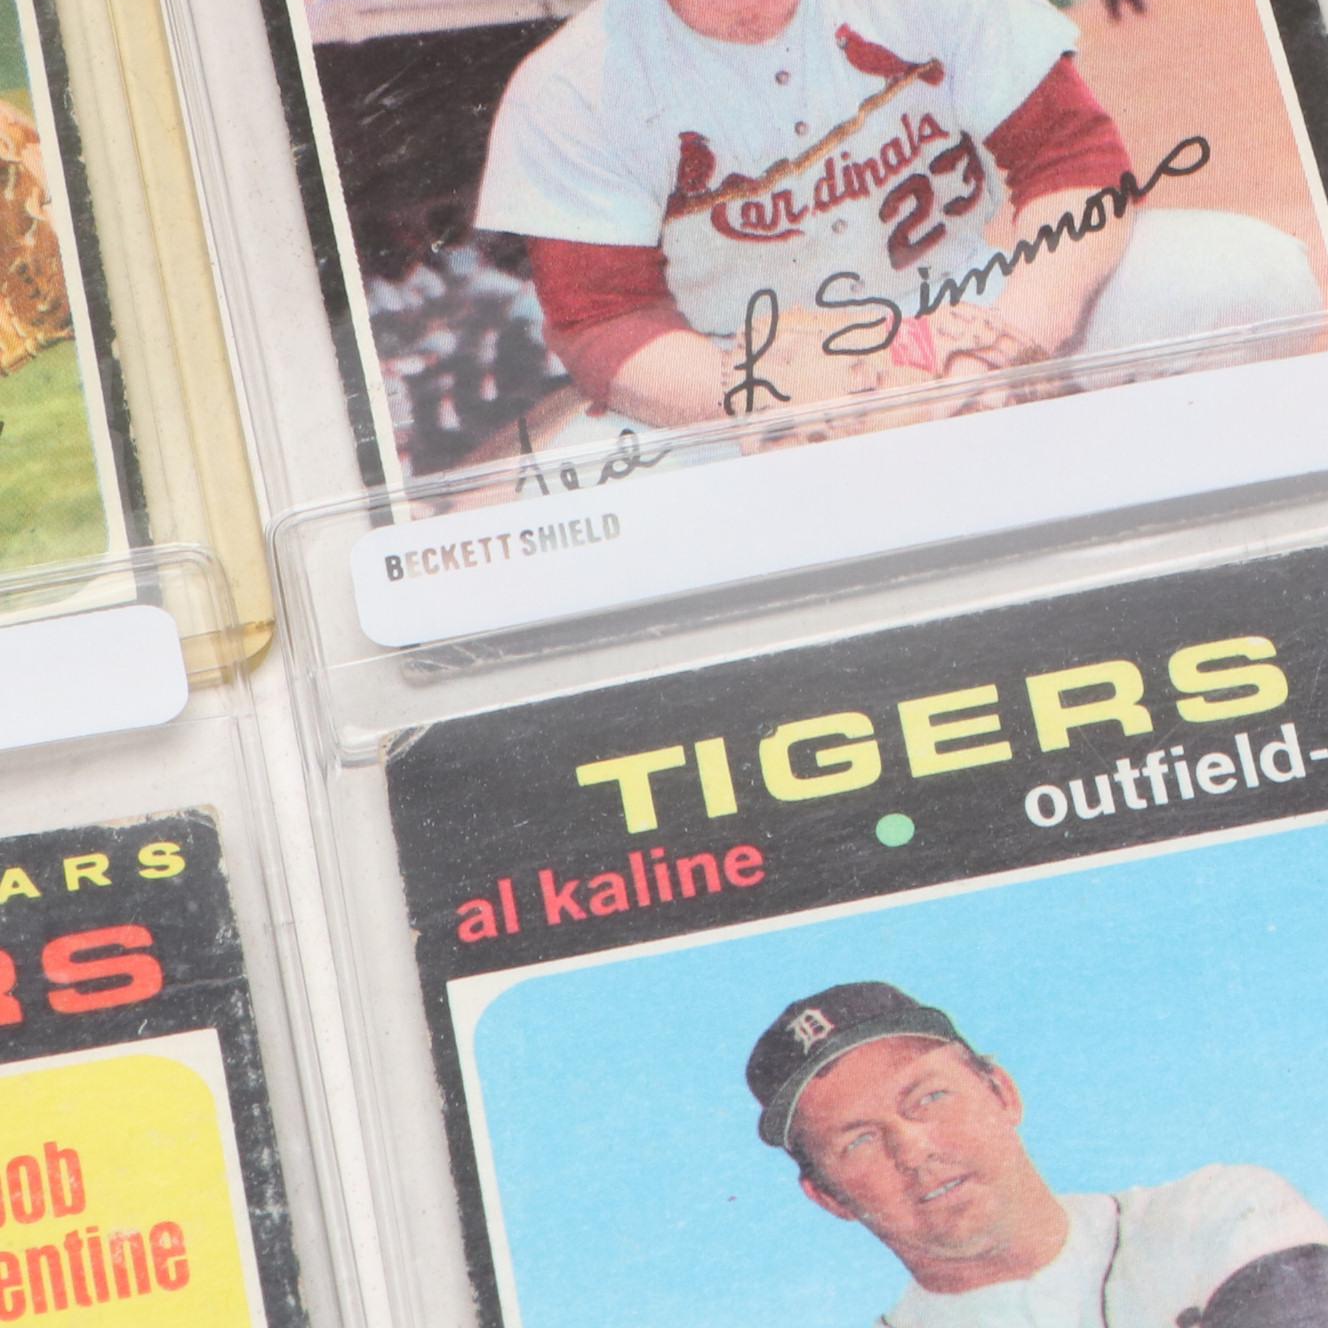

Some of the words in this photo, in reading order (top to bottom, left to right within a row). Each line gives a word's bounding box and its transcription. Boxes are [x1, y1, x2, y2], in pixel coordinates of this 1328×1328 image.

[710, 112, 950, 241] Cardinals
[877, 130, 987, 271] 23
[384, 533, 511, 582] BECKETT
[519, 513, 622, 557] SHIELD
[576, 635, 1289, 834] TIGERS
[455, 879, 521, 943] al
[545, 844, 767, 927] kaline
